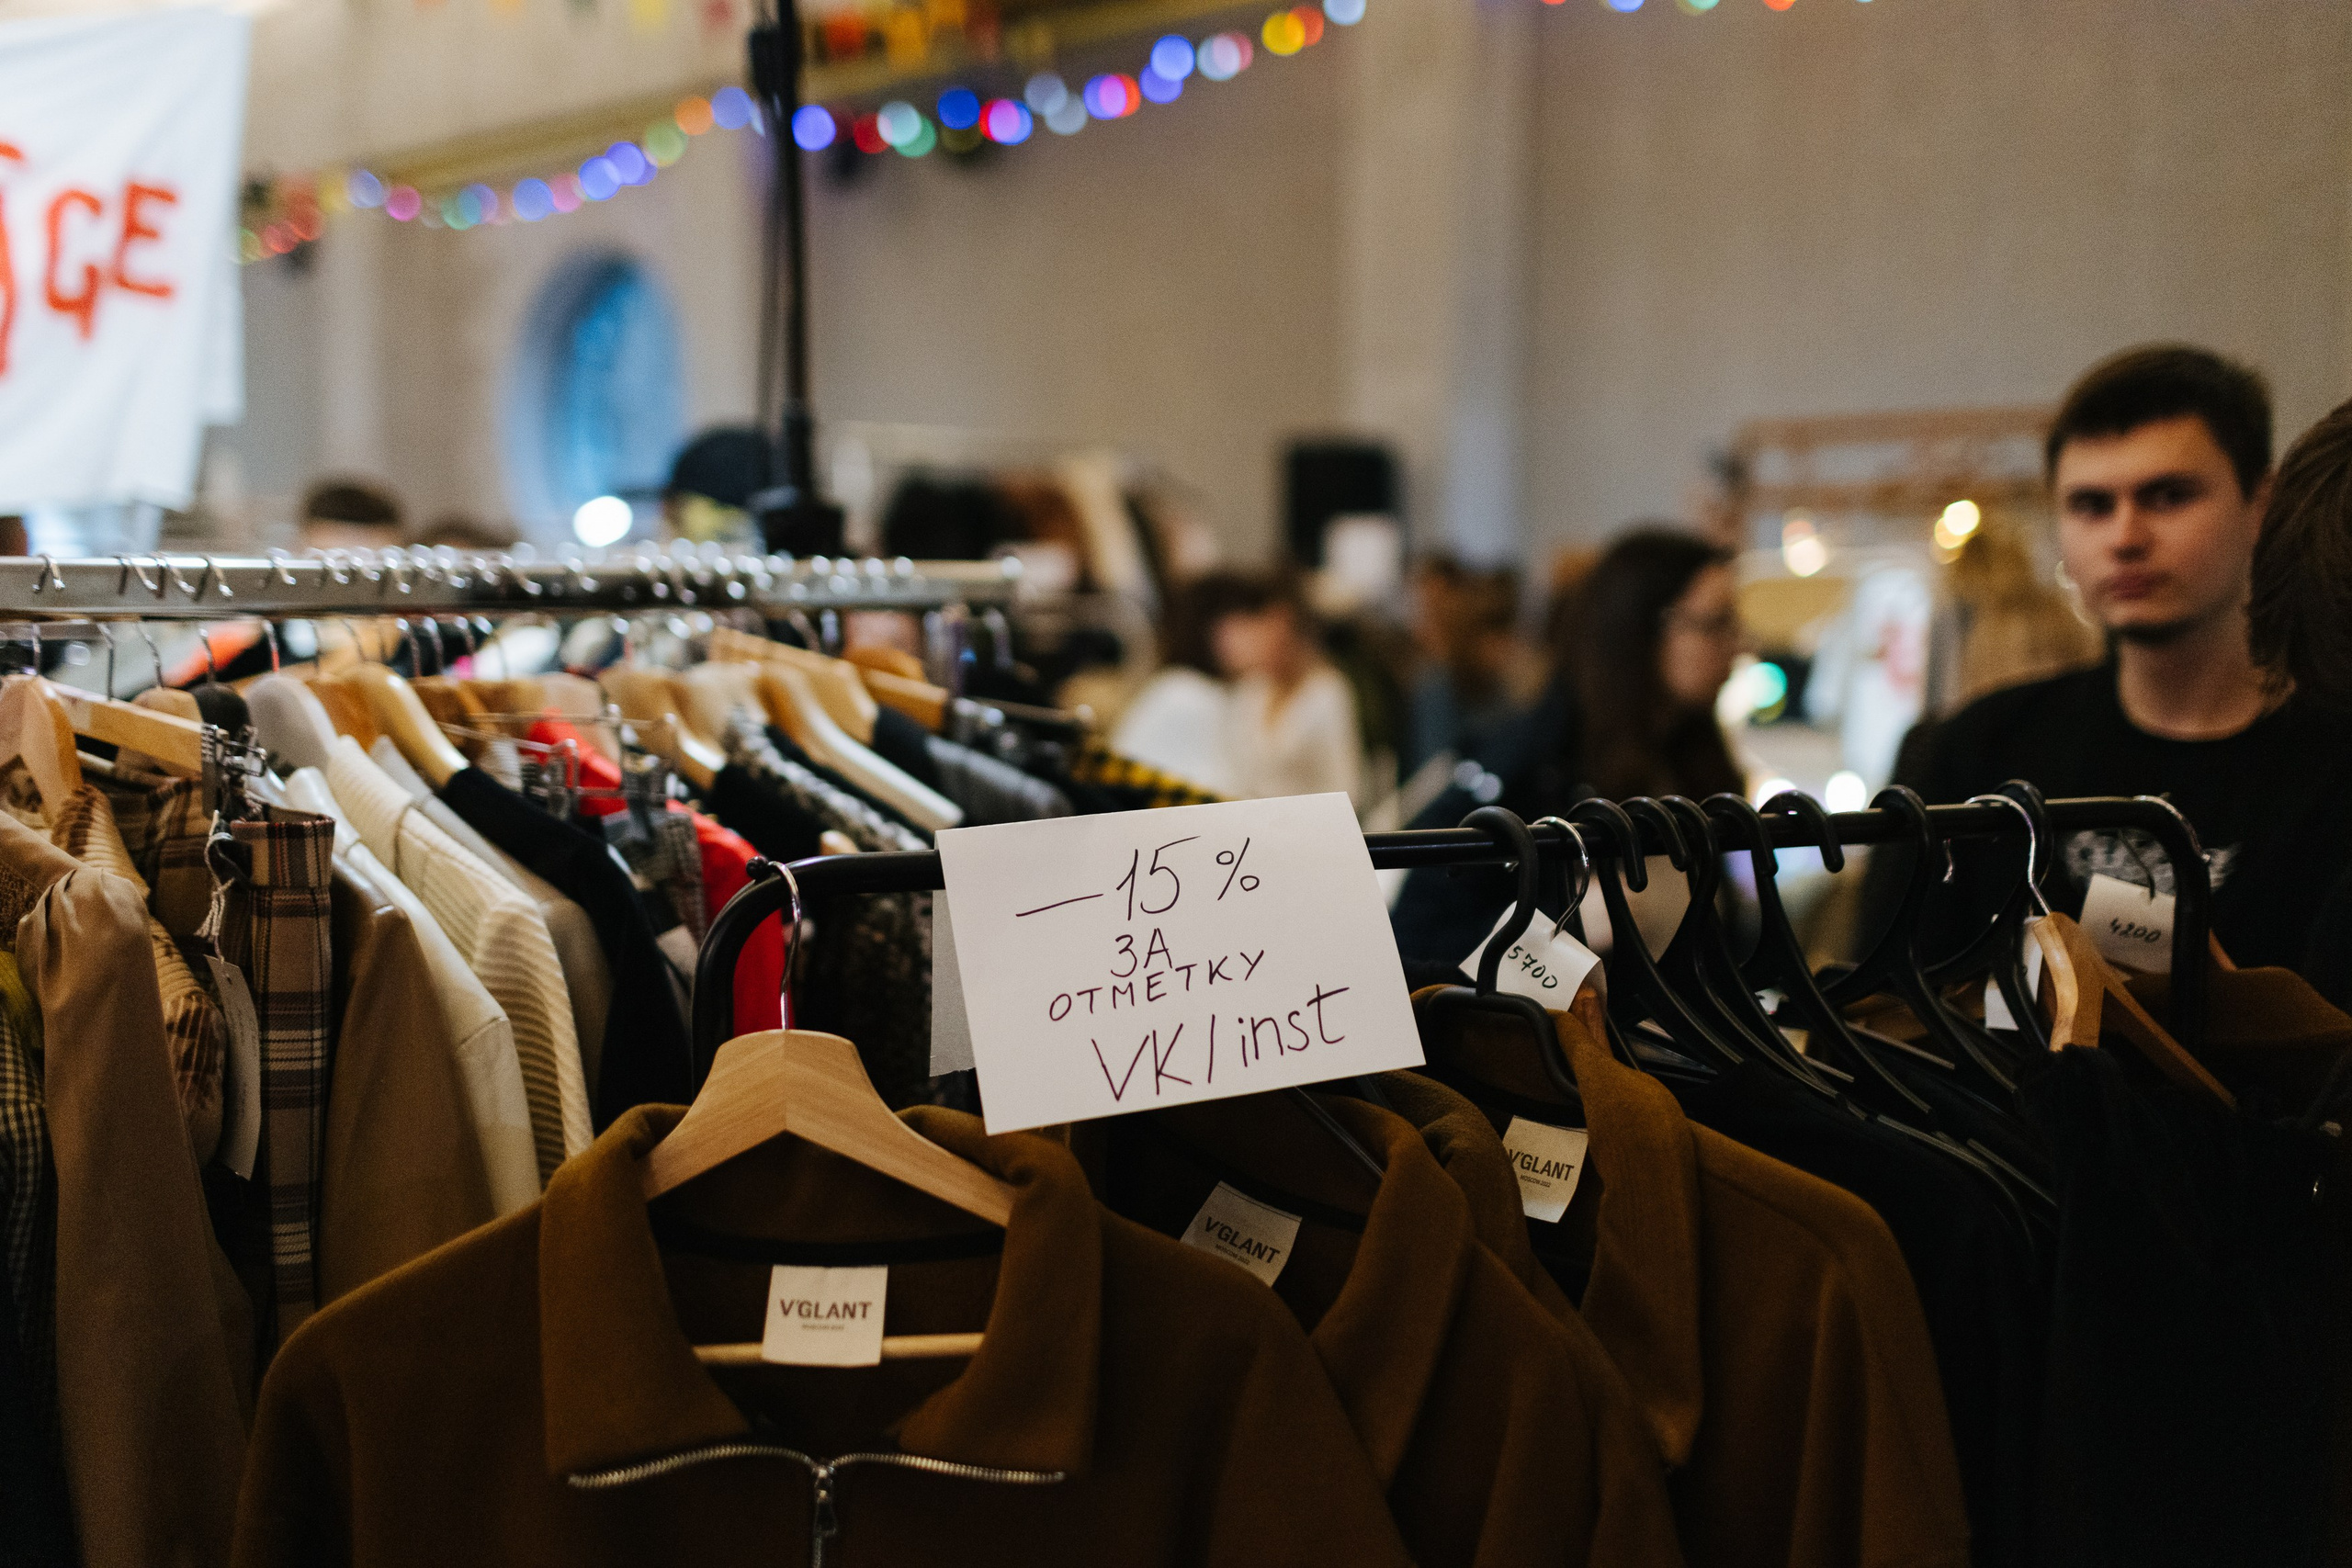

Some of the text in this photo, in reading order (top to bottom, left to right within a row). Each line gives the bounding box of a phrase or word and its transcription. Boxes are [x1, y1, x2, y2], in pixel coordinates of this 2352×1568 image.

[1110, 928, 1173, 977] ЗА
[2109, 918, 2162, 944] 4200
[1048, 949, 1265, 1021] ОТМЕТКУ
[1507, 944, 1559, 989] 5700
[1204, 1215, 1281, 1265] V'GLANT
[779, 1298, 873, 1320] V'GLANT
